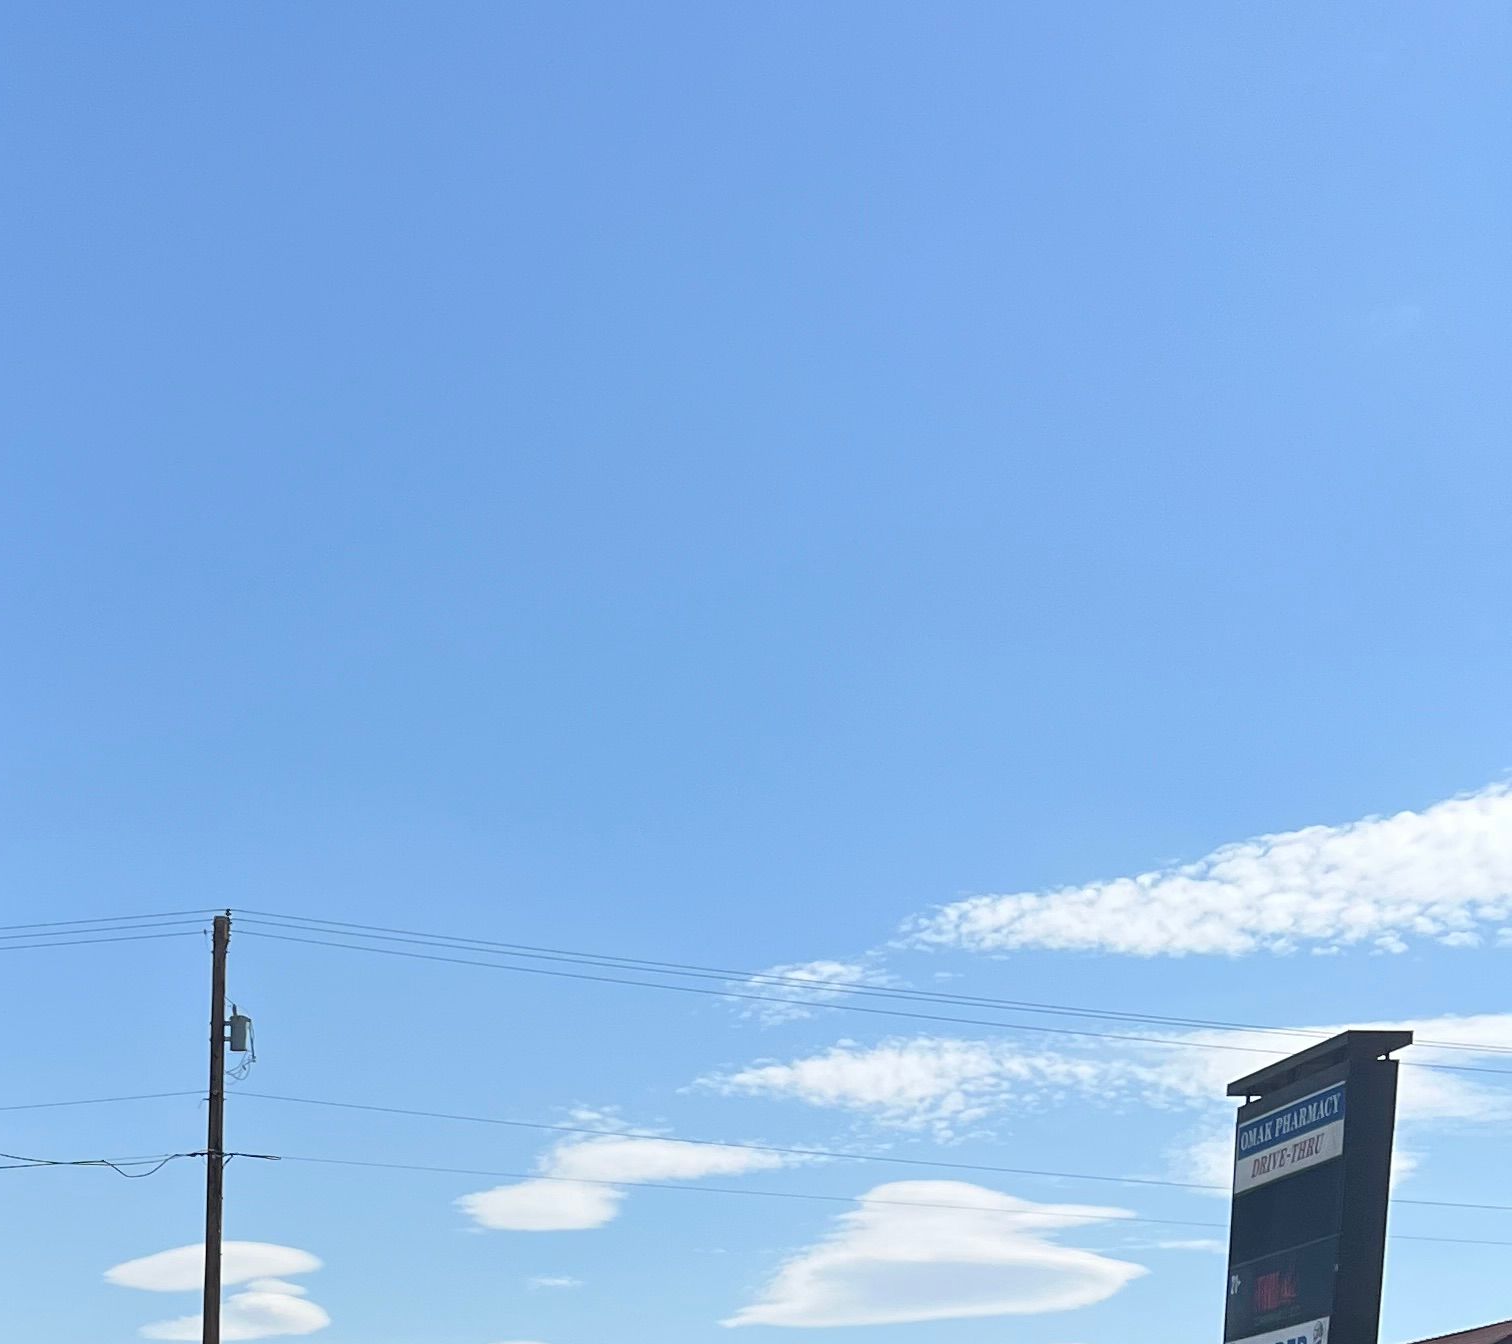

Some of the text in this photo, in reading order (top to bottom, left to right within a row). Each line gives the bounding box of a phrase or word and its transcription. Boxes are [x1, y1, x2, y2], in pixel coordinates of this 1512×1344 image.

[1240, 1092, 1341, 1151] OMAK PHARMACY
[1251, 1132, 1325, 1178] DRIVE-THRU
